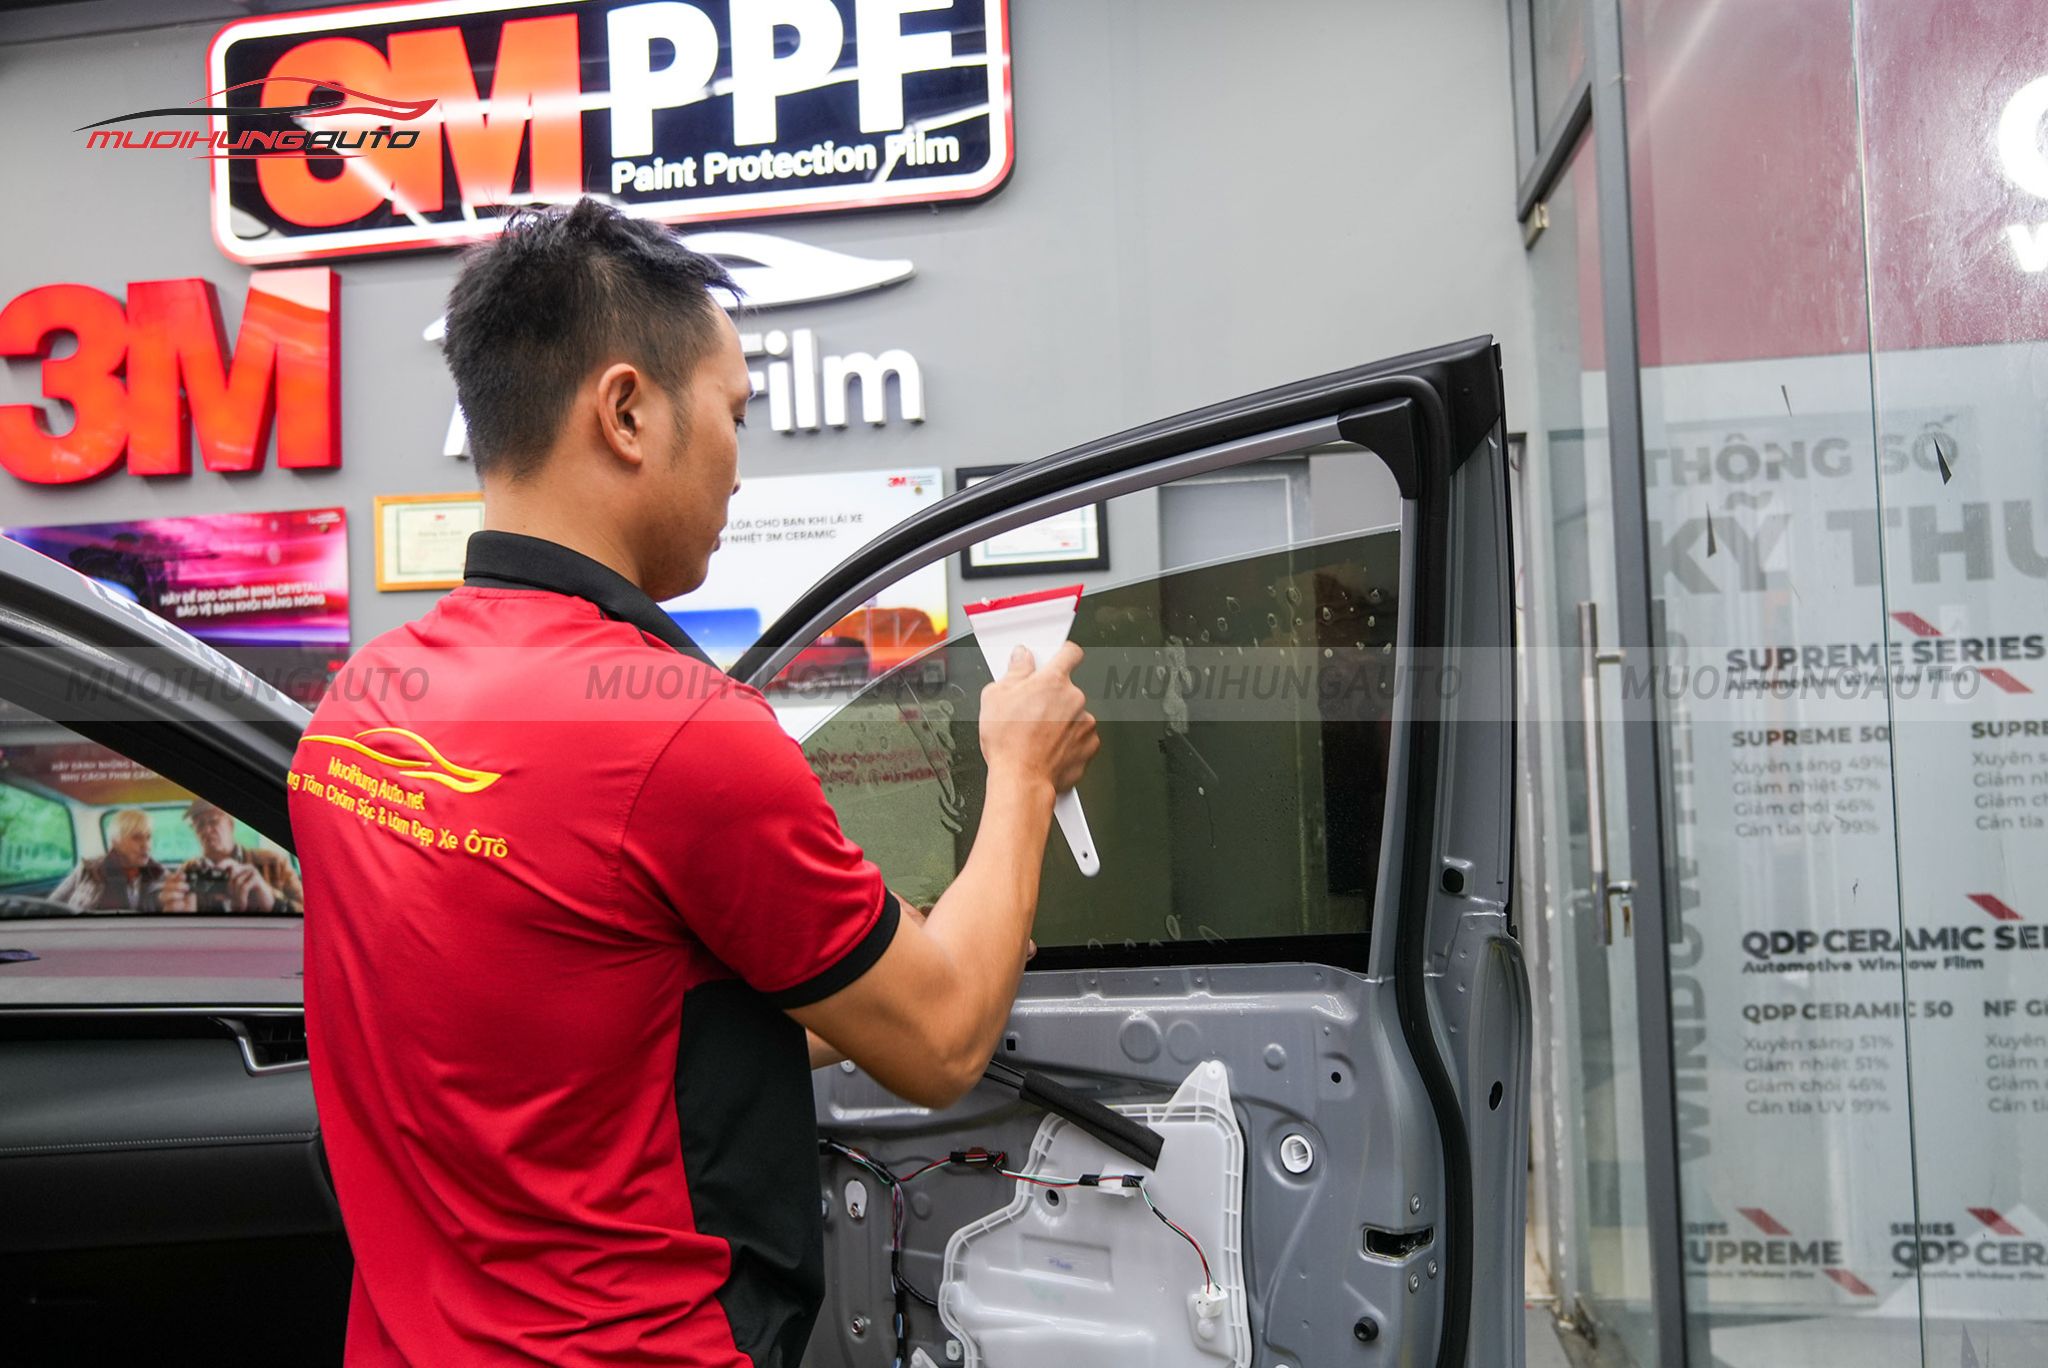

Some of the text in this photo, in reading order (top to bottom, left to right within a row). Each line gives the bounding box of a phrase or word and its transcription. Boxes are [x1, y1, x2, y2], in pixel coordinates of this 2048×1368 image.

[256, 0, 954, 227] 3M PPF
[611, 132, 960, 194] Paint Protection Film
[0, 266, 342, 485] 3M
[755, 517, 780, 528] CHO
[809, 515, 827, 525] KHI
[850, 513, 864, 523] XE
[765, 532, 782, 542] 3M
[785, 529, 836, 541] CERAMIC
[1726, 634, 2046, 673] SUPREME SERIES
[1732, 726, 1889, 747] SUPREME 50
[377, 806, 387, 825] &
[437, 828, 459, 850] Xe
[1742, 930, 1820, 962] QDP
[1823, 925, 1986, 953] CERAMIC
[1742, 955, 1985, 974] Automotive Winow Film
[1742, 1001, 1953, 1024] QDP CERAMIC 50
[1984, 999, 2017, 1017] NF
[1686, 1241, 1843, 1266] UPREME
